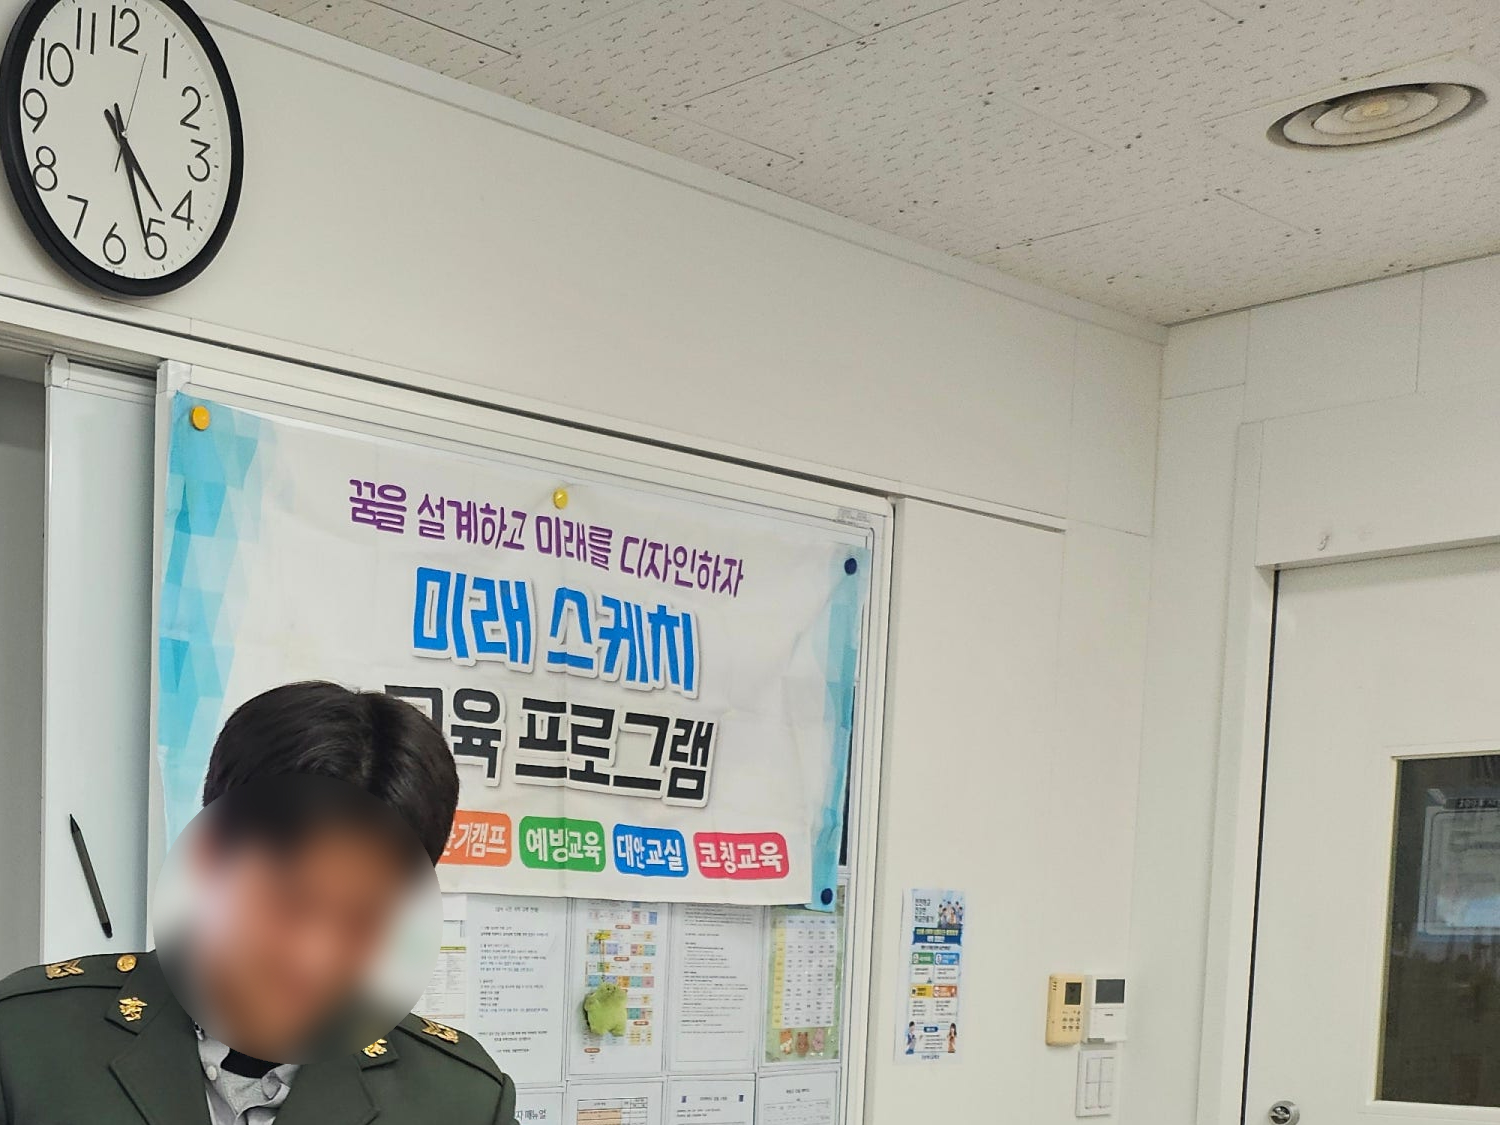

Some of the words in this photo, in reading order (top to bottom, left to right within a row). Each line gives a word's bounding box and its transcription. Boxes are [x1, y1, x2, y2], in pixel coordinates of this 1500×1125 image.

[75, 7, 97, 56] 11
[109, 4, 141, 55] 12
[39, 37, 75, 88] 10
[162, 37, 169, 80] 1
[22, 88, 48, 134] 9
[179, 85, 202, 131] 2
[32, 145, 59, 192] 8
[186, 139, 211, 183] 3
[67, 194, 89, 240] 7
[170, 190, 195, 232] 4
[102, 222, 127, 266] 6
[145, 217, 168, 261] 5
[349, 479, 407, 534] 꿈을
[417, 492, 528, 551] 설계하고
[535, 515, 613, 571] 미래를
[620, 535, 744, 599] 디자인하자
[412, 566, 532, 665] 미래
[546, 584, 696, 693] 스케치
[514, 697, 715, 801] 프로그램
[525, 827, 603, 866] 예방교육
[615, 833, 685, 872] 대안교실
[698, 841, 784, 874] 코칭교육
